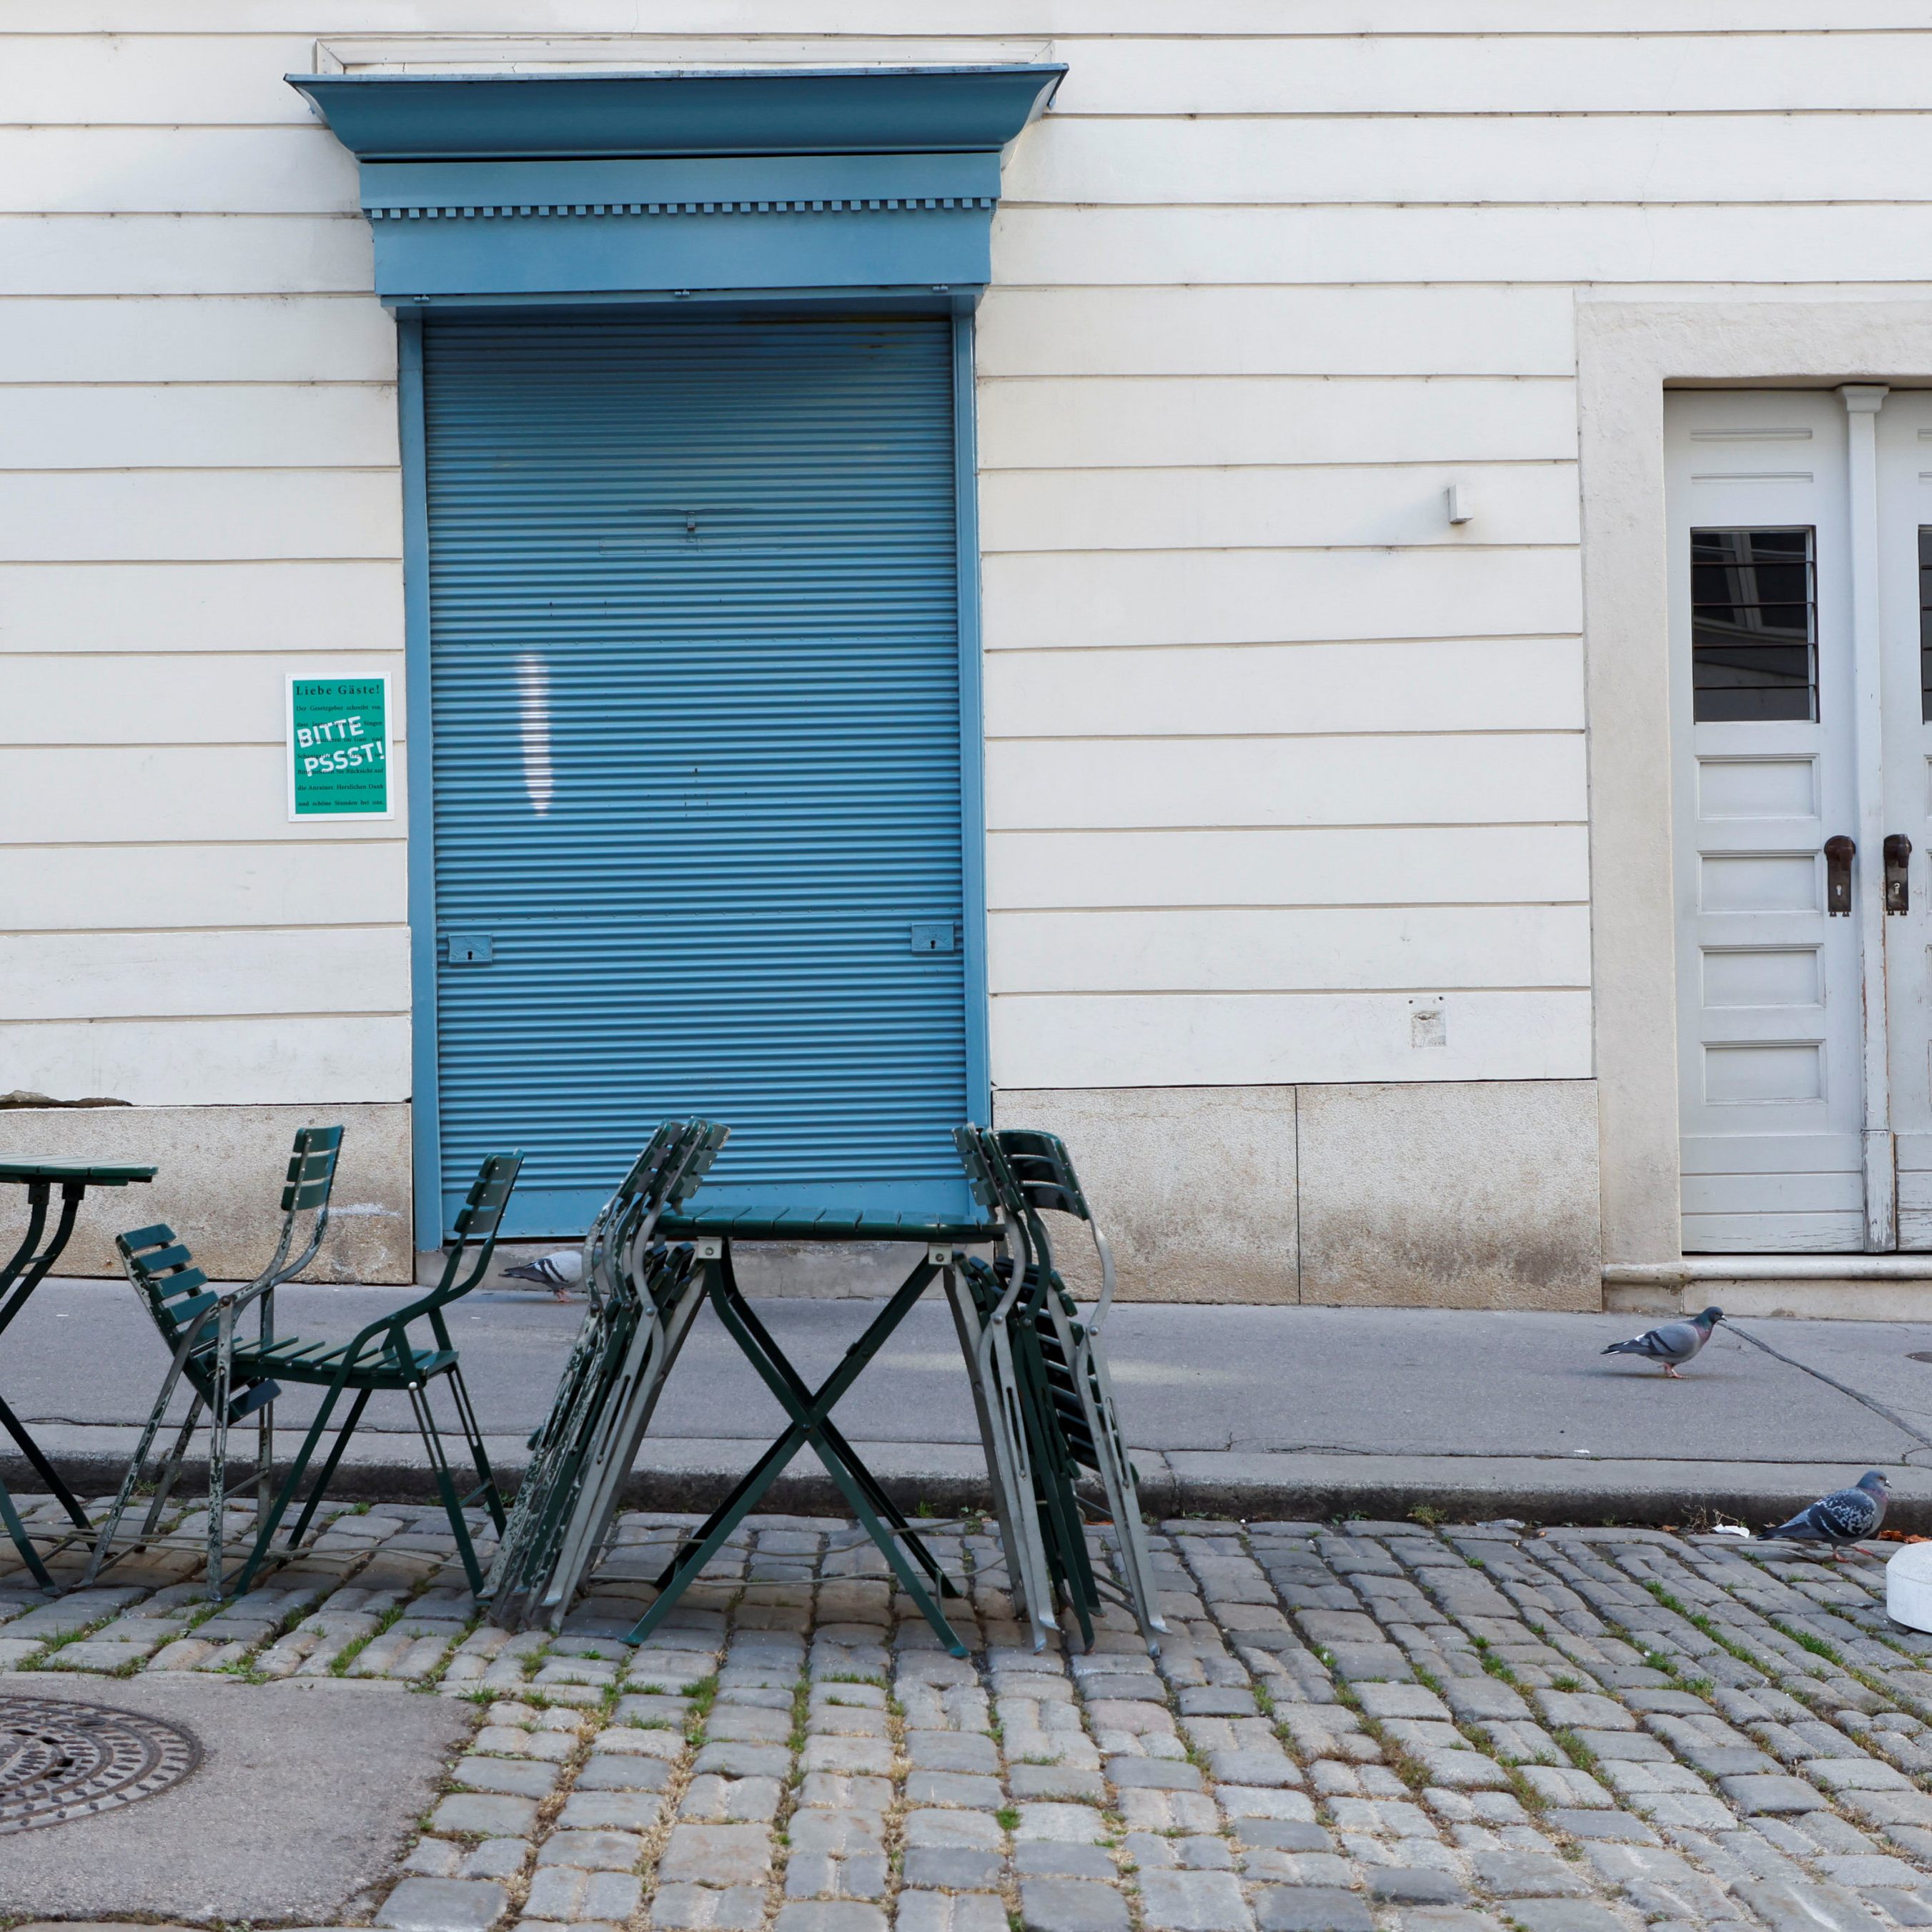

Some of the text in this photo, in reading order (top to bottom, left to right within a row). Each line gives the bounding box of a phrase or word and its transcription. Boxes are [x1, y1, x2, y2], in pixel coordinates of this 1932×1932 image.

[297, 684, 380, 695] Liebe Gäste!
[297, 715, 365, 748] BITTE
[304, 740, 385, 778] PSSST!
